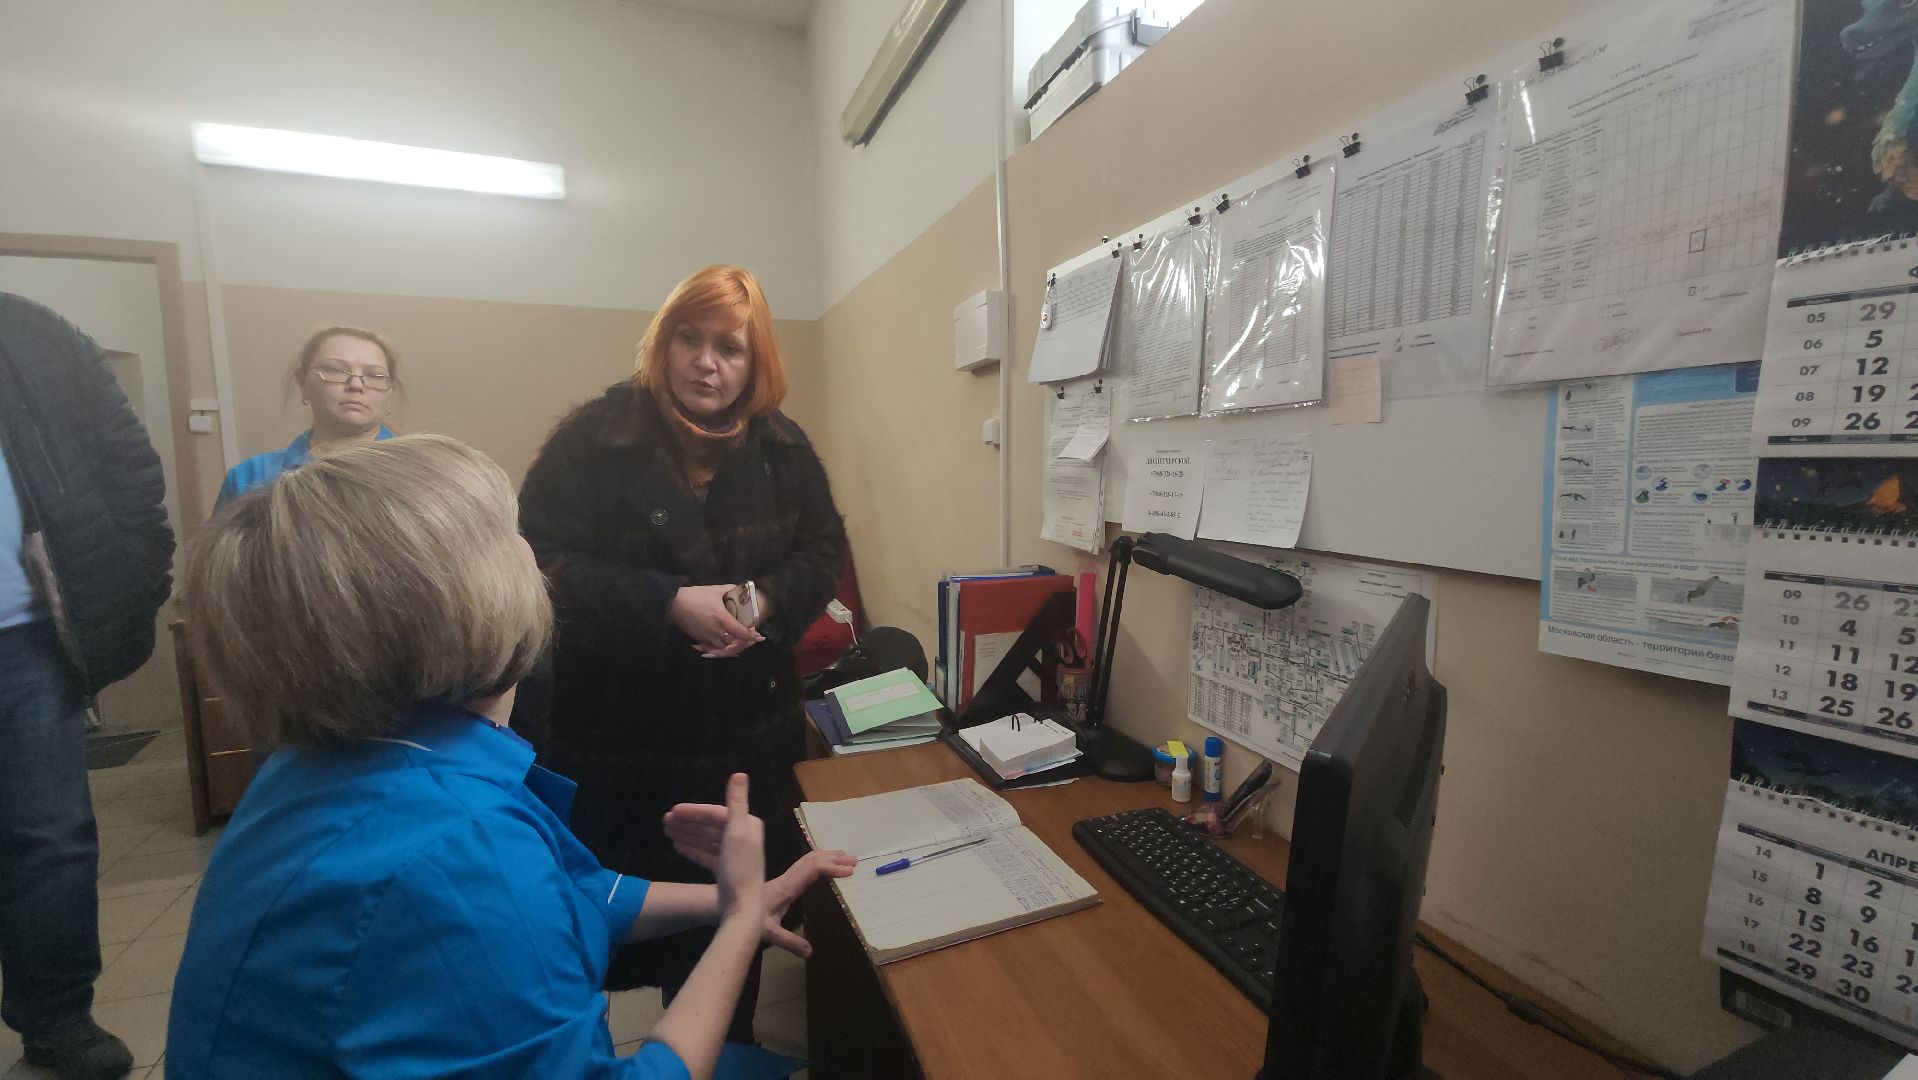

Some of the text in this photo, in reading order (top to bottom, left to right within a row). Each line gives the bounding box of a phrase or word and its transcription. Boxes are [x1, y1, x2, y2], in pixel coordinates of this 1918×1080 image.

[1807, 301, 1896, 323] 05 29
[1803, 329, 1882, 350] 06 5
[1800, 357, 1889, 375] 07 12
[1795, 392, 1814, 401] 08
[1853, 384, 1885, 403] 19
[1792, 418, 1811, 428] 09
[1844, 412, 1880, 430] 26
[1783, 590, 1802, 599] 09
[1836, 592, 1870, 611] 26
[1548, 625, 1595, 641] Московская
[1597, 629, 1634, 645] область
[1642, 641, 1704, 658] территория
[1782, 615, 1916, 645] 10 4 5
[1779, 639, 1918, 675] 11 11 12
[1776, 664, 1918, 701] 12 18 19
[1772, 689, 1913, 729] 13 25 26
[1757, 846, 1883, 899] 14 1 2
[1753, 870, 1767, 883] 15
[1805, 887, 1822, 905] 8
[1861, 906, 1877, 923] 9
[1749, 893, 1764, 906] 16
[1798, 909, 1825, 932] 15
[1849, 929, 1879, 953] 16
[1744, 917, 1759, 929] 17
[1788, 933, 1822, 958] 22
[1841, 954, 1874, 978] 23
[1785, 958, 1817, 980] 29
[1836, 979, 1870, 1003] 30
